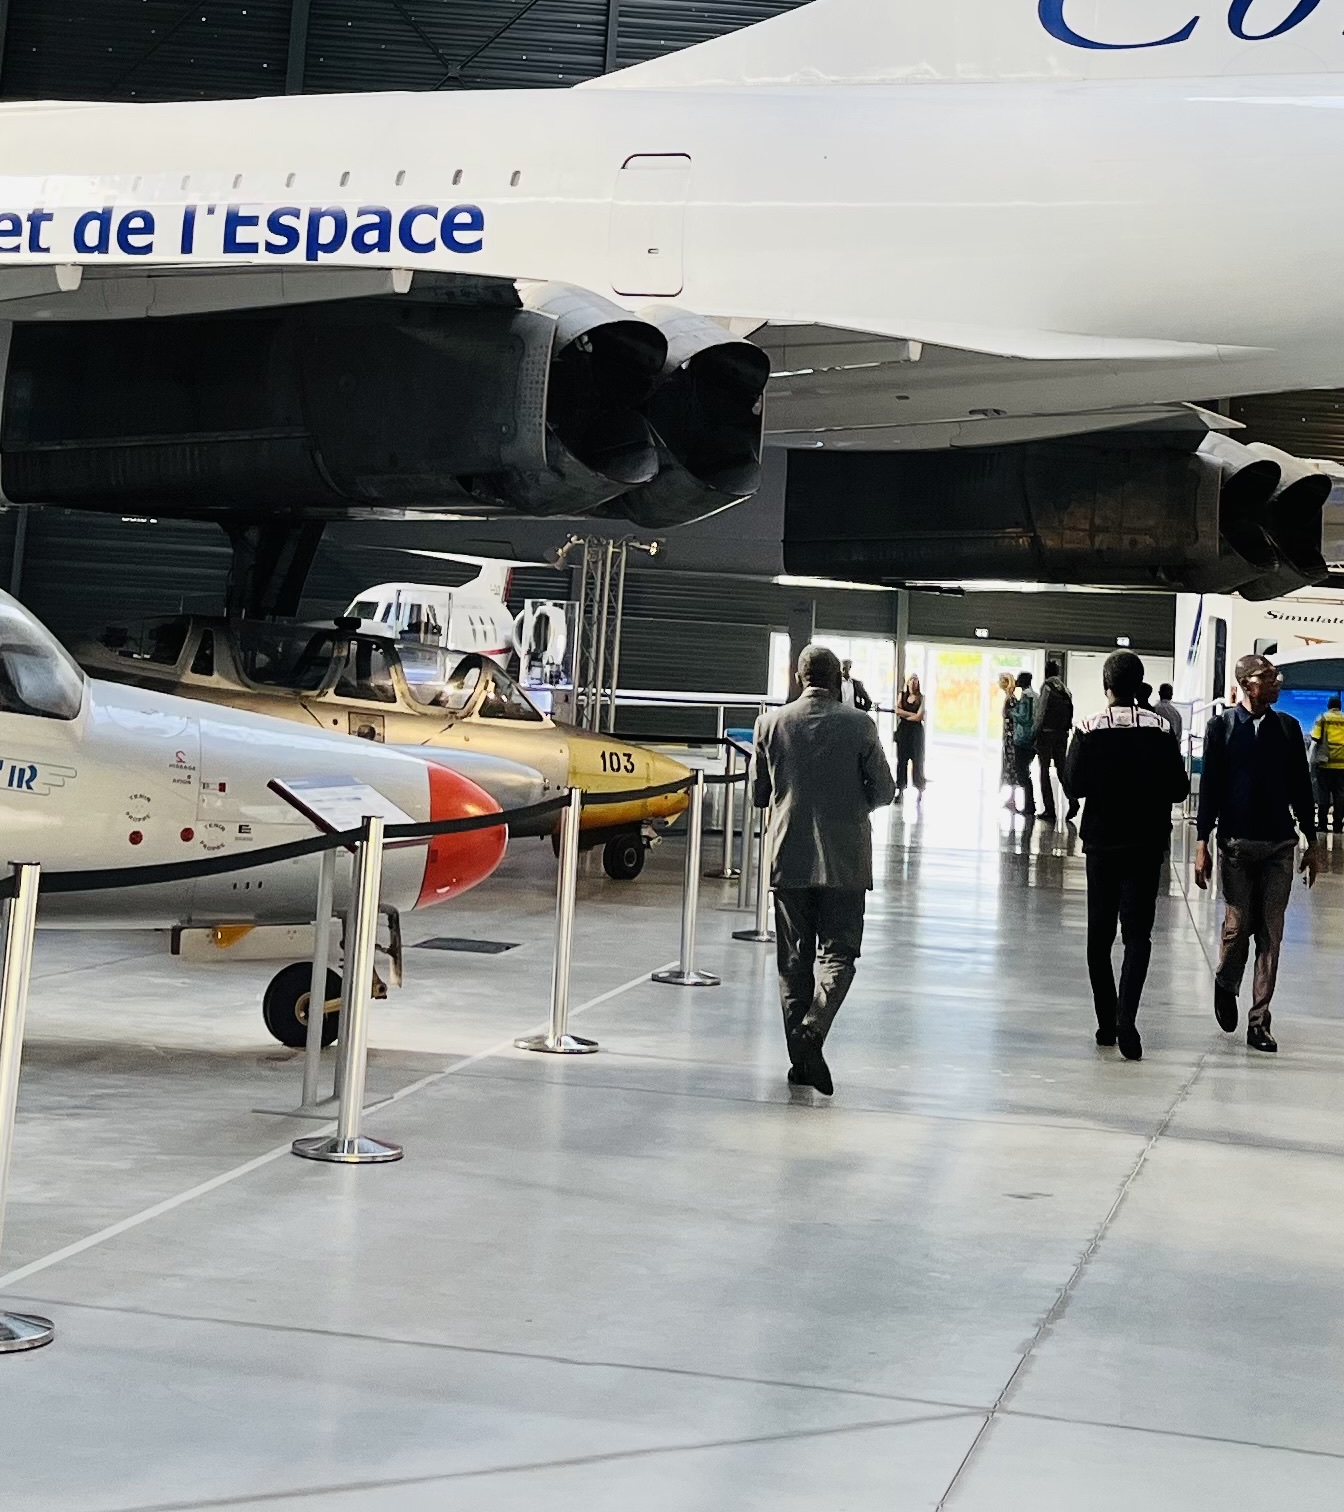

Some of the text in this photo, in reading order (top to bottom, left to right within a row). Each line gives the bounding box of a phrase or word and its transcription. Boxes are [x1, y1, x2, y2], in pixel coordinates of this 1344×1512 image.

[72, 203, 156, 256] de
[179, 202, 486, 262] l'Espace
[600, 750, 635, 774] 103
